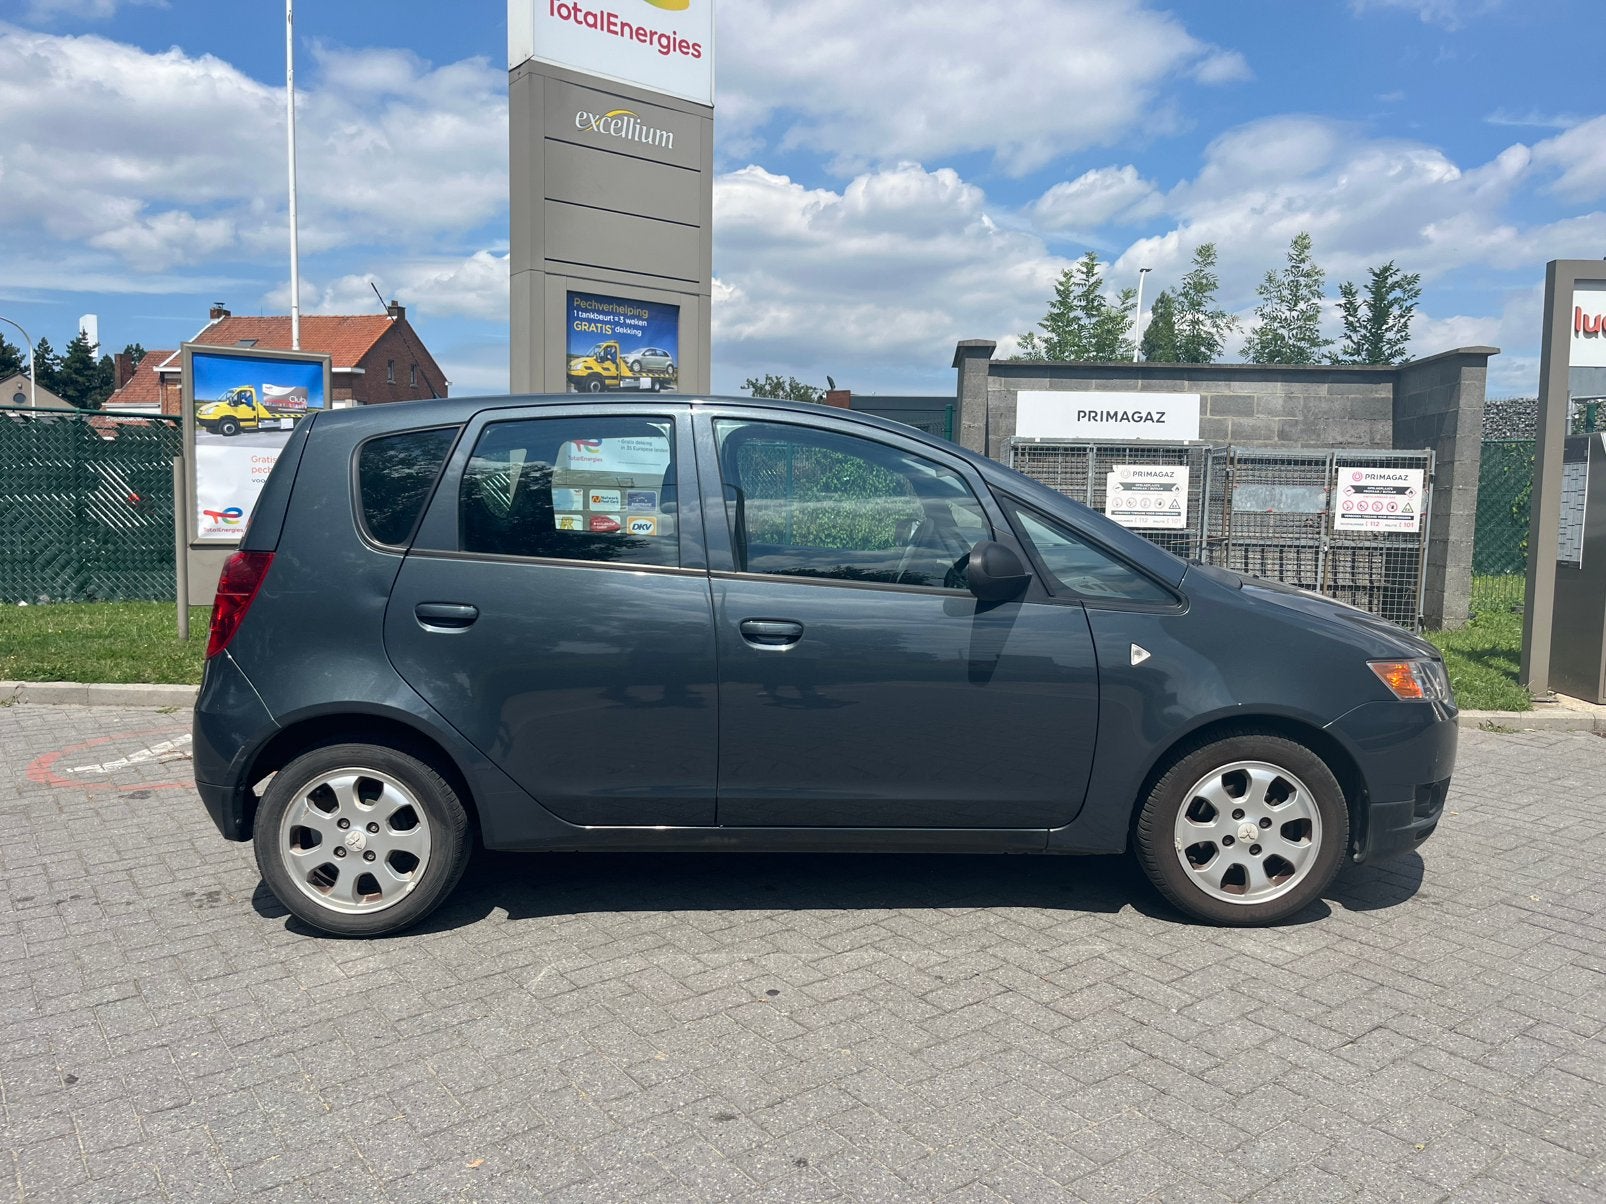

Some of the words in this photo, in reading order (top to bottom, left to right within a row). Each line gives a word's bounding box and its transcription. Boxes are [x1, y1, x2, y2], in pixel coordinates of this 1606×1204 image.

[549, 0, 703, 59] TotalEnergies
[575, 110, 674, 149] excellium
[573, 297, 649, 318] Pechverhelping
[579, 311, 614, 322] tankbeurt
[625, 317, 648, 327] weken
[615, 326, 642, 337] dekking
[1077, 410, 1166, 423] PRIMAGAZ
[567, 455, 603, 463] TotalEnergies
[632, 523, 653, 531] DKV
